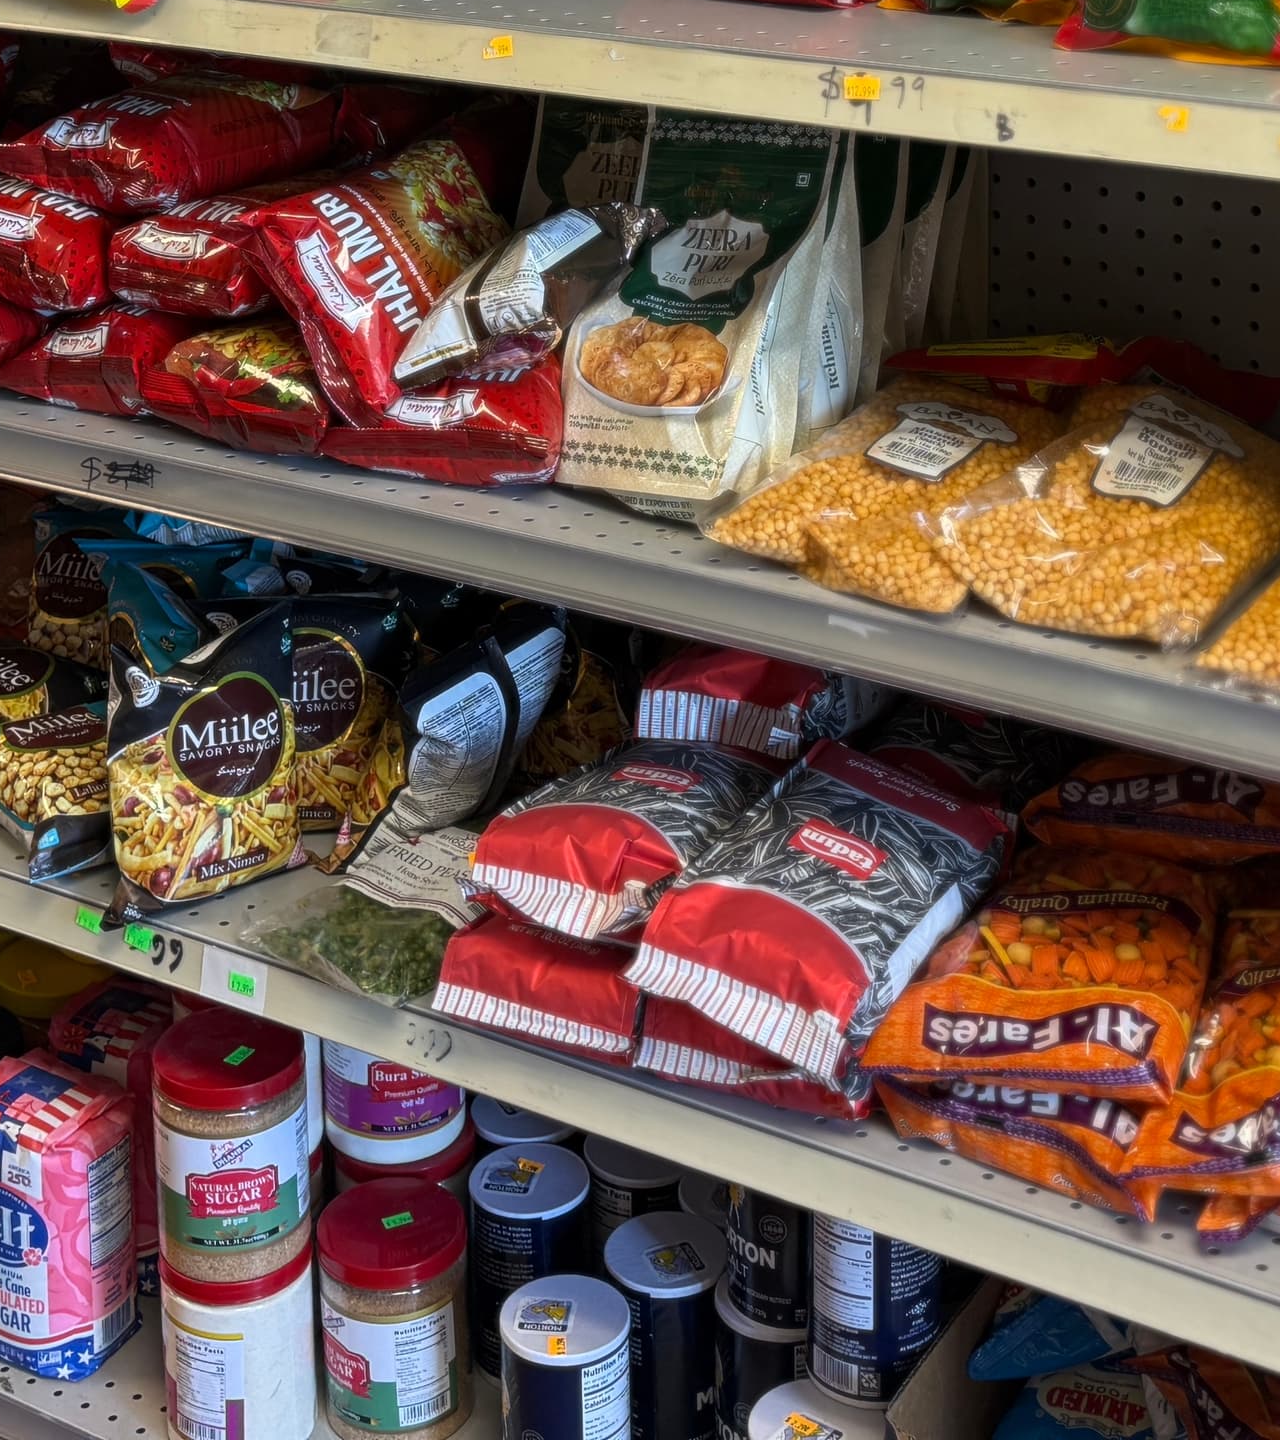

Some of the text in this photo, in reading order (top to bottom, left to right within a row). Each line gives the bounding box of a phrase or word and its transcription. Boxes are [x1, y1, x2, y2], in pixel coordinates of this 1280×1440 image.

[684, 226, 752, 250] ZEERA
[311, 191, 424, 334] JHAL MURI
[682, 250, 734, 274] PURI
[293, 671, 358, 705] iilee
[305, 699, 357, 715] SNACKS
[178, 711, 280, 753] Miilee
[179, 734, 282, 763] SAVORY SNACKS
[619, 765, 680, 788] tadim
[385, 841, 432, 875] FRIED
[800, 824, 886, 877] tadim
[200, 852, 266, 880] Mix Nimco
[999, 890, 1170, 914] Premium Quality
[374, 1069, 408, 1083] Bura
[383, 1082, 440, 1100] Premium Quality
[190, 1172, 275, 1197] NATURAL BROWN
[204, 1187, 262, 1205] SUGAR
[5, 1276, 32, 1299] Cane
[520, 1322, 569, 1333] MORTON
[582, 1358, 617, 1380] Nutrition
[583, 1393, 612, 1409] Calories
